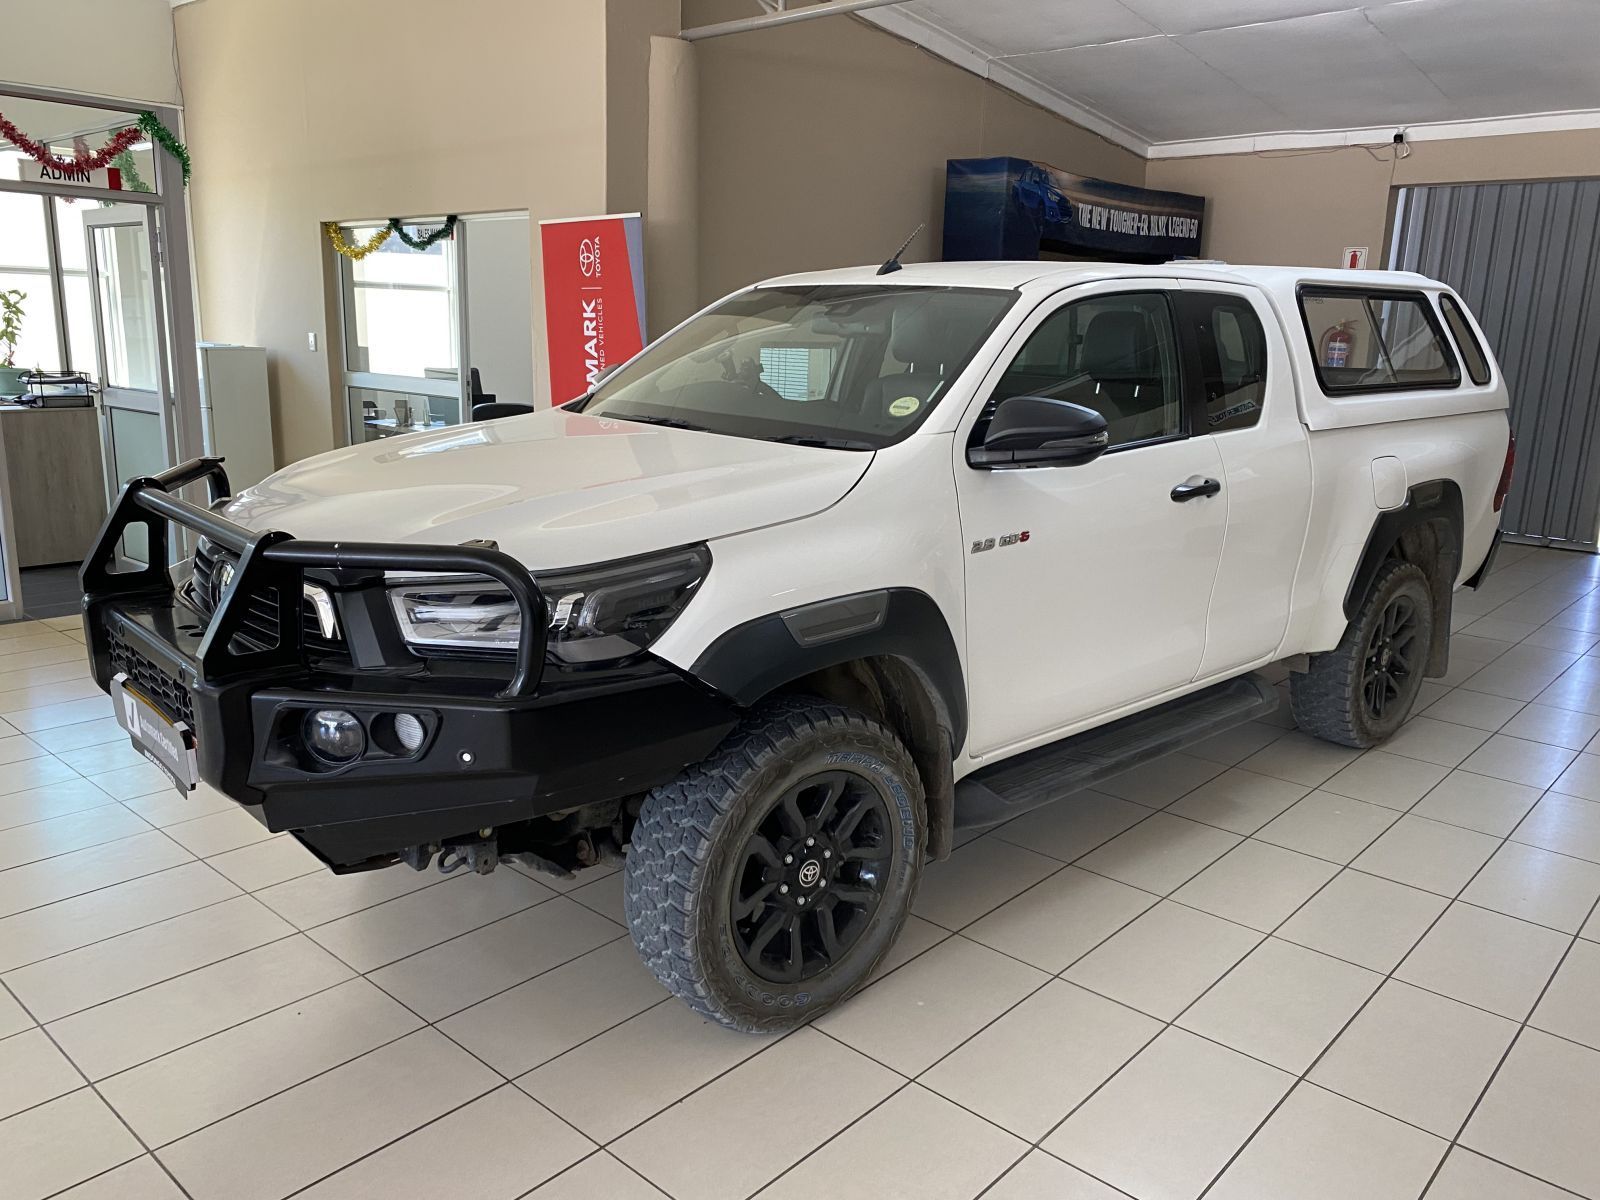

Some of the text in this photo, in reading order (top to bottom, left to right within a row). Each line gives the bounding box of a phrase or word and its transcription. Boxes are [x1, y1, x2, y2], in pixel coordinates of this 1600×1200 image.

[40, 165, 91, 183] ADMIN
[1078, 203, 1092, 228] THE
[1092, 206, 1109, 231] NEW
[1168, 216, 1190, 238] LEGEND
[597, 298, 605, 346] VEHICLES
[582, 299, 599, 390] MARK
